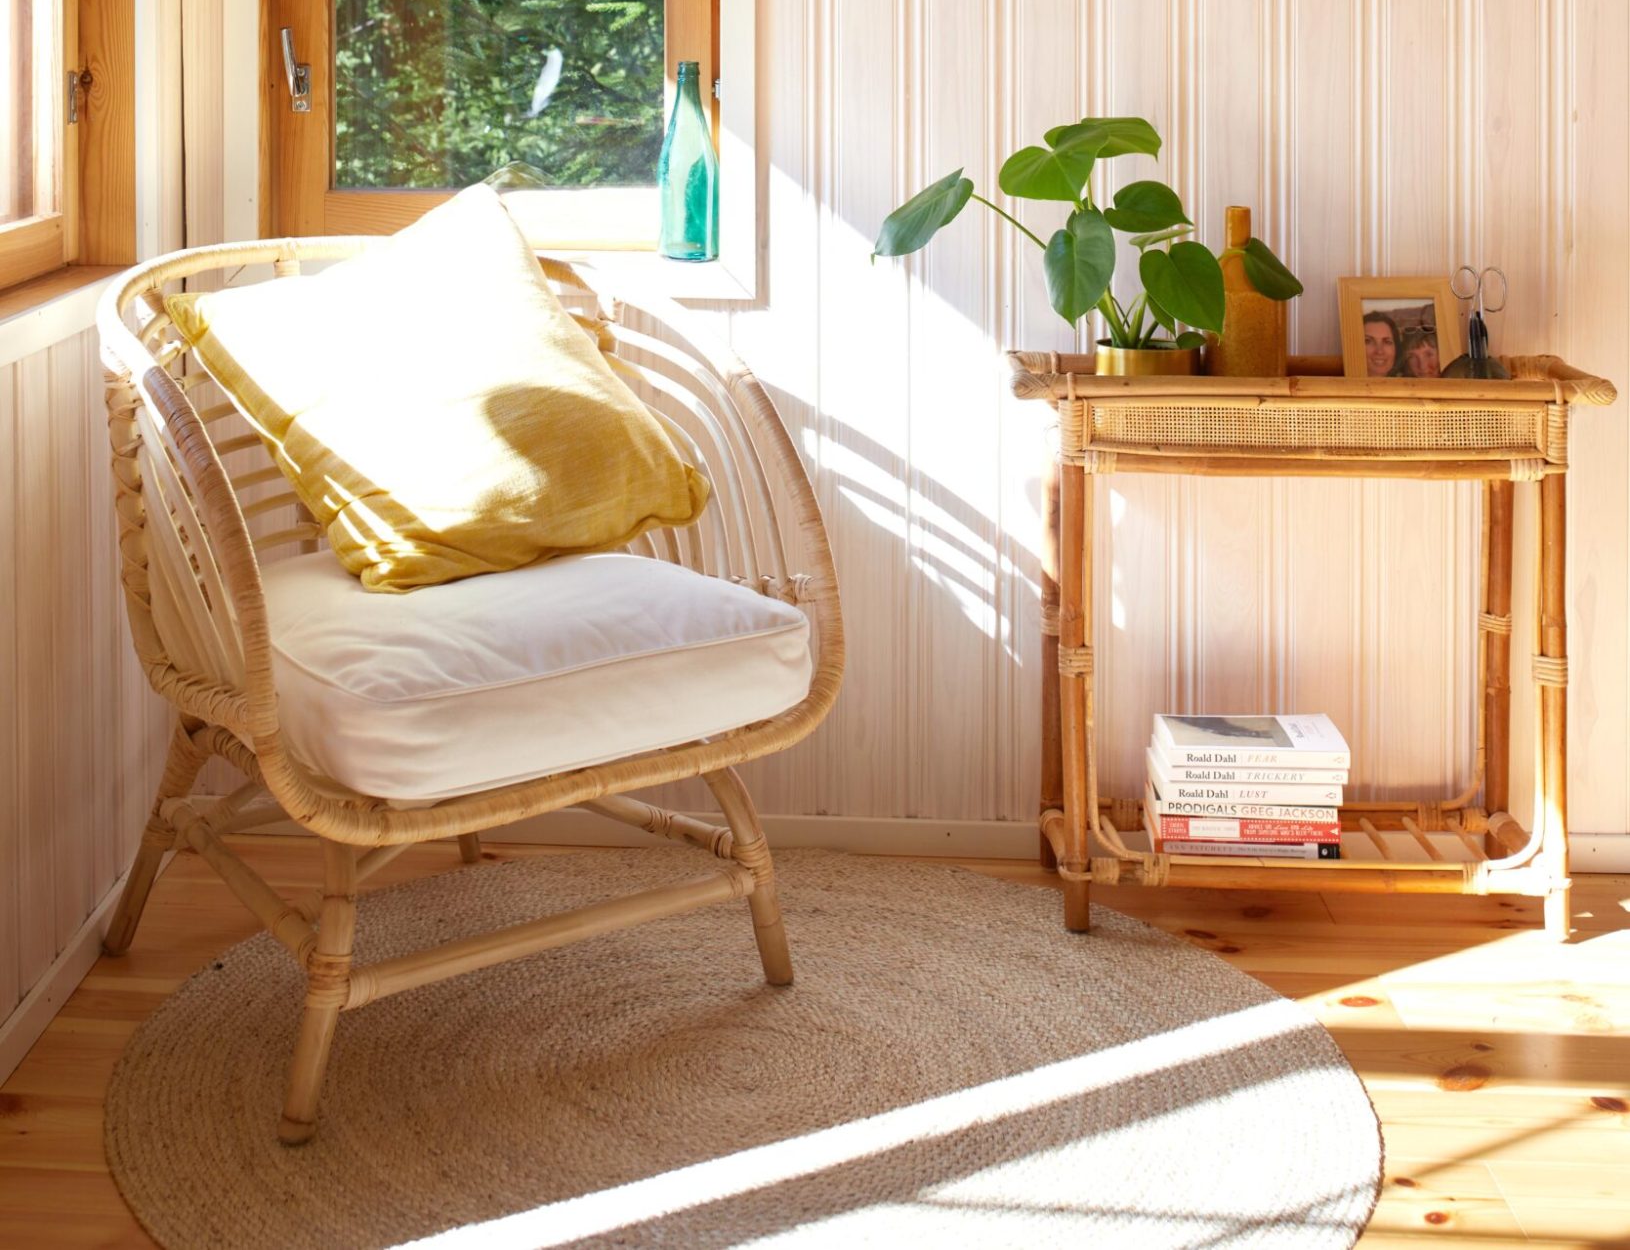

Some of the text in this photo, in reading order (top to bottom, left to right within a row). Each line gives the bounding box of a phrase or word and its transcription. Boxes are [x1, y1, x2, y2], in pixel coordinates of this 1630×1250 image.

[1186, 753, 1278, 763] Roald Dahl FEAR
[1185, 770, 1305, 781] Roald Dahl TRICKERY
[1178, 788, 1269, 799] Roald Dahl LUST
[1168, 802, 1335, 819] PRODIGALS GREG JACKSON
